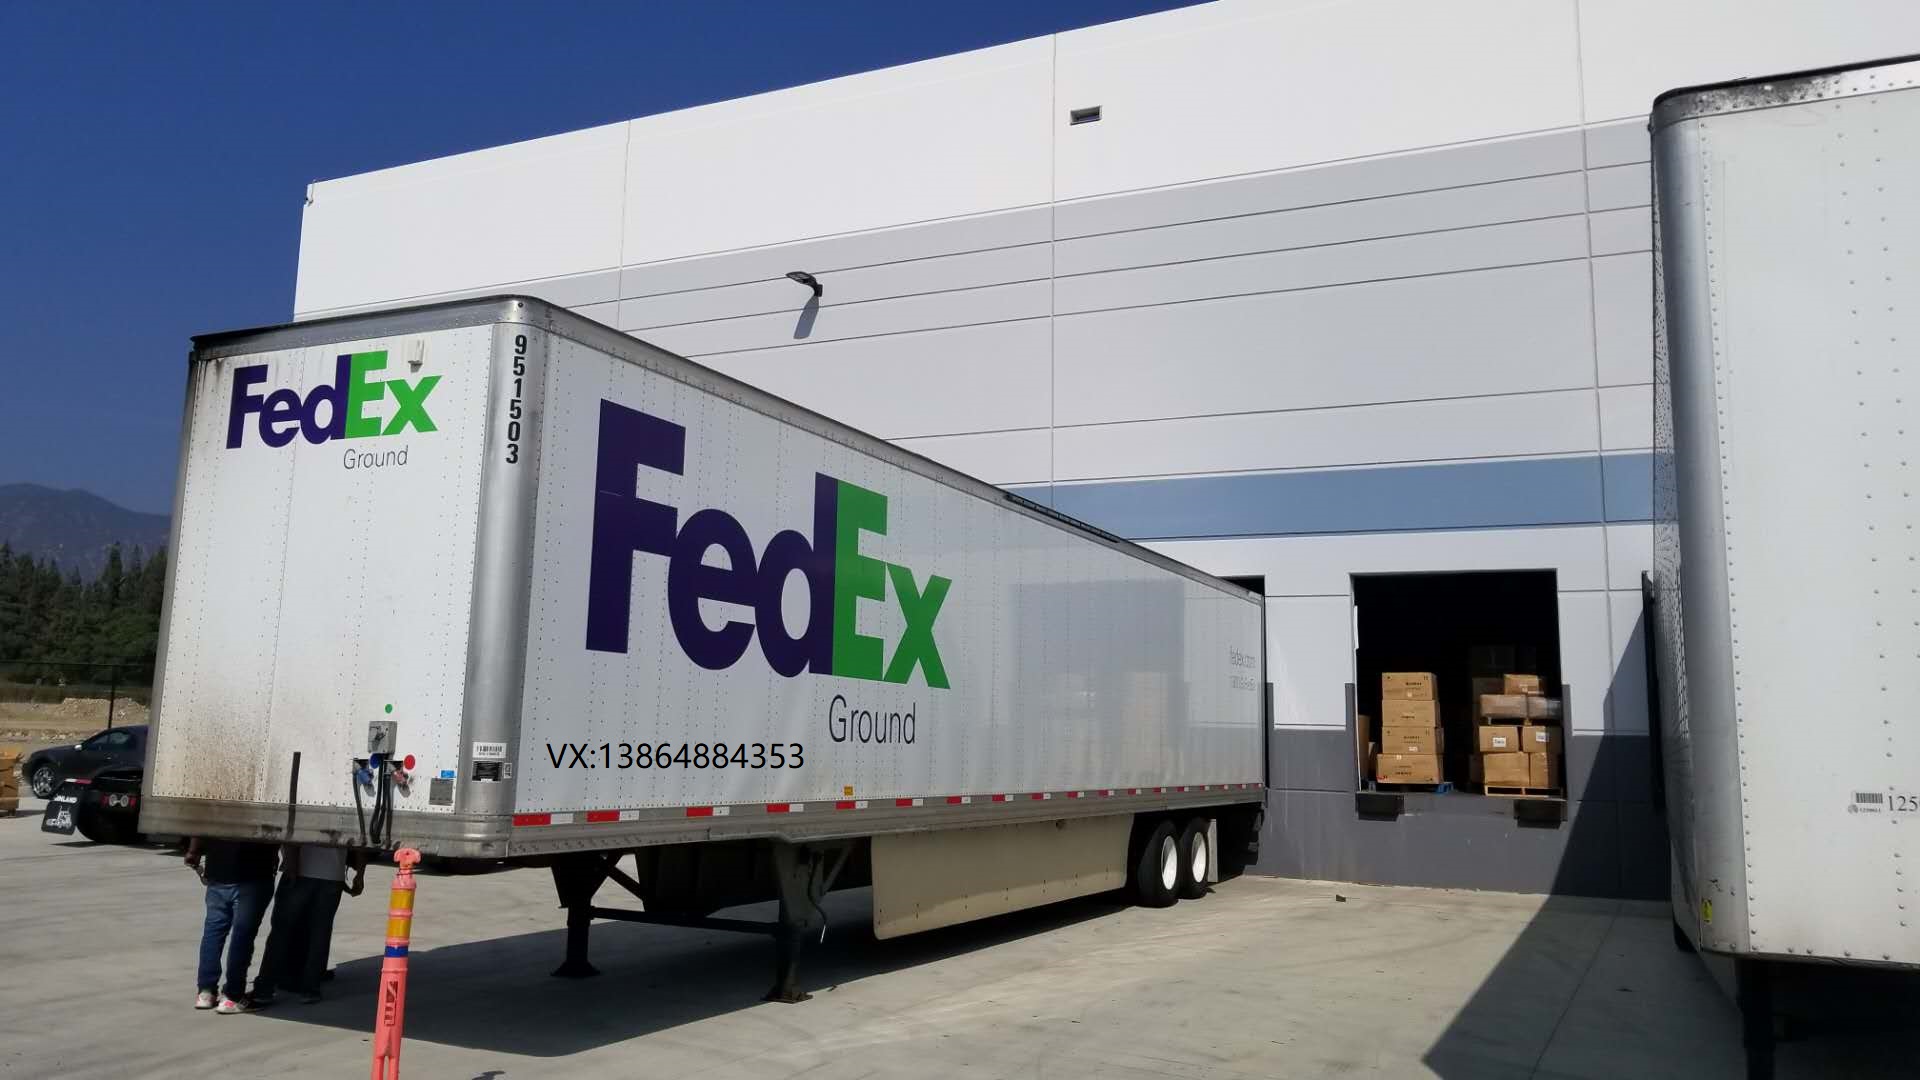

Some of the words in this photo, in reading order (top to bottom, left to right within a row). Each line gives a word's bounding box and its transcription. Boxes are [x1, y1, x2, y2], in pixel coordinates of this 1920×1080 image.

[226, 350, 442, 449] FedEx
[505, 334, 528, 464] 951503
[343, 445, 409, 470] Ground
[585, 398, 952, 689] FedEx
[828, 694, 917, 745] Ground
[1888, 795, 1920, 812] 125
